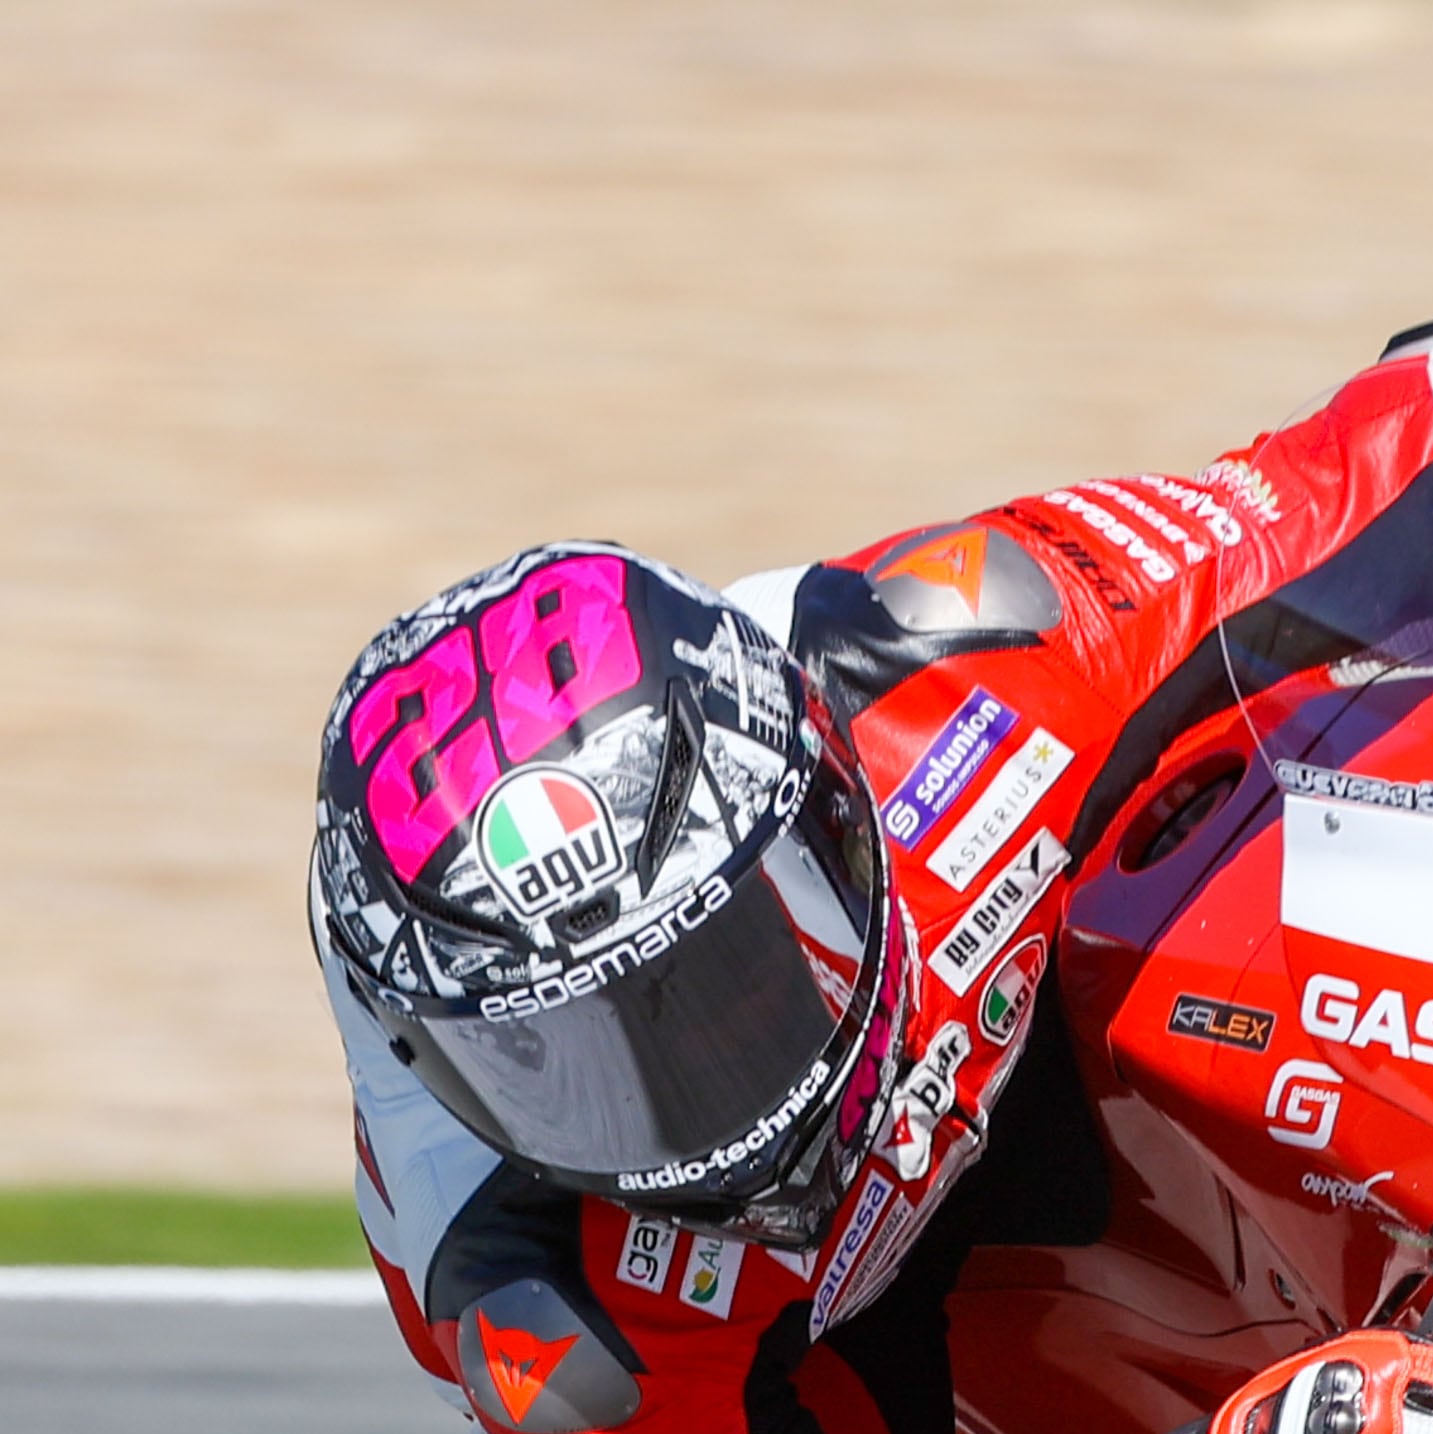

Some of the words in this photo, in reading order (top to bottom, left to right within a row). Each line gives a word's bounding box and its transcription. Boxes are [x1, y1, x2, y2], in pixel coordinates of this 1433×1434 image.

[1043, 489, 1176, 583] GASGAS
[349, 555, 642, 885] 28
[916, 697, 1002, 805] solunion
[515, 830, 608, 904] agv
[948, 765, 1043, 881] ASTERIUS
[1173, 1000, 1270, 1046] KALEX
[617, 1059, 831, 1191] audio-technica
[813, 1181, 887, 1326] valresa
